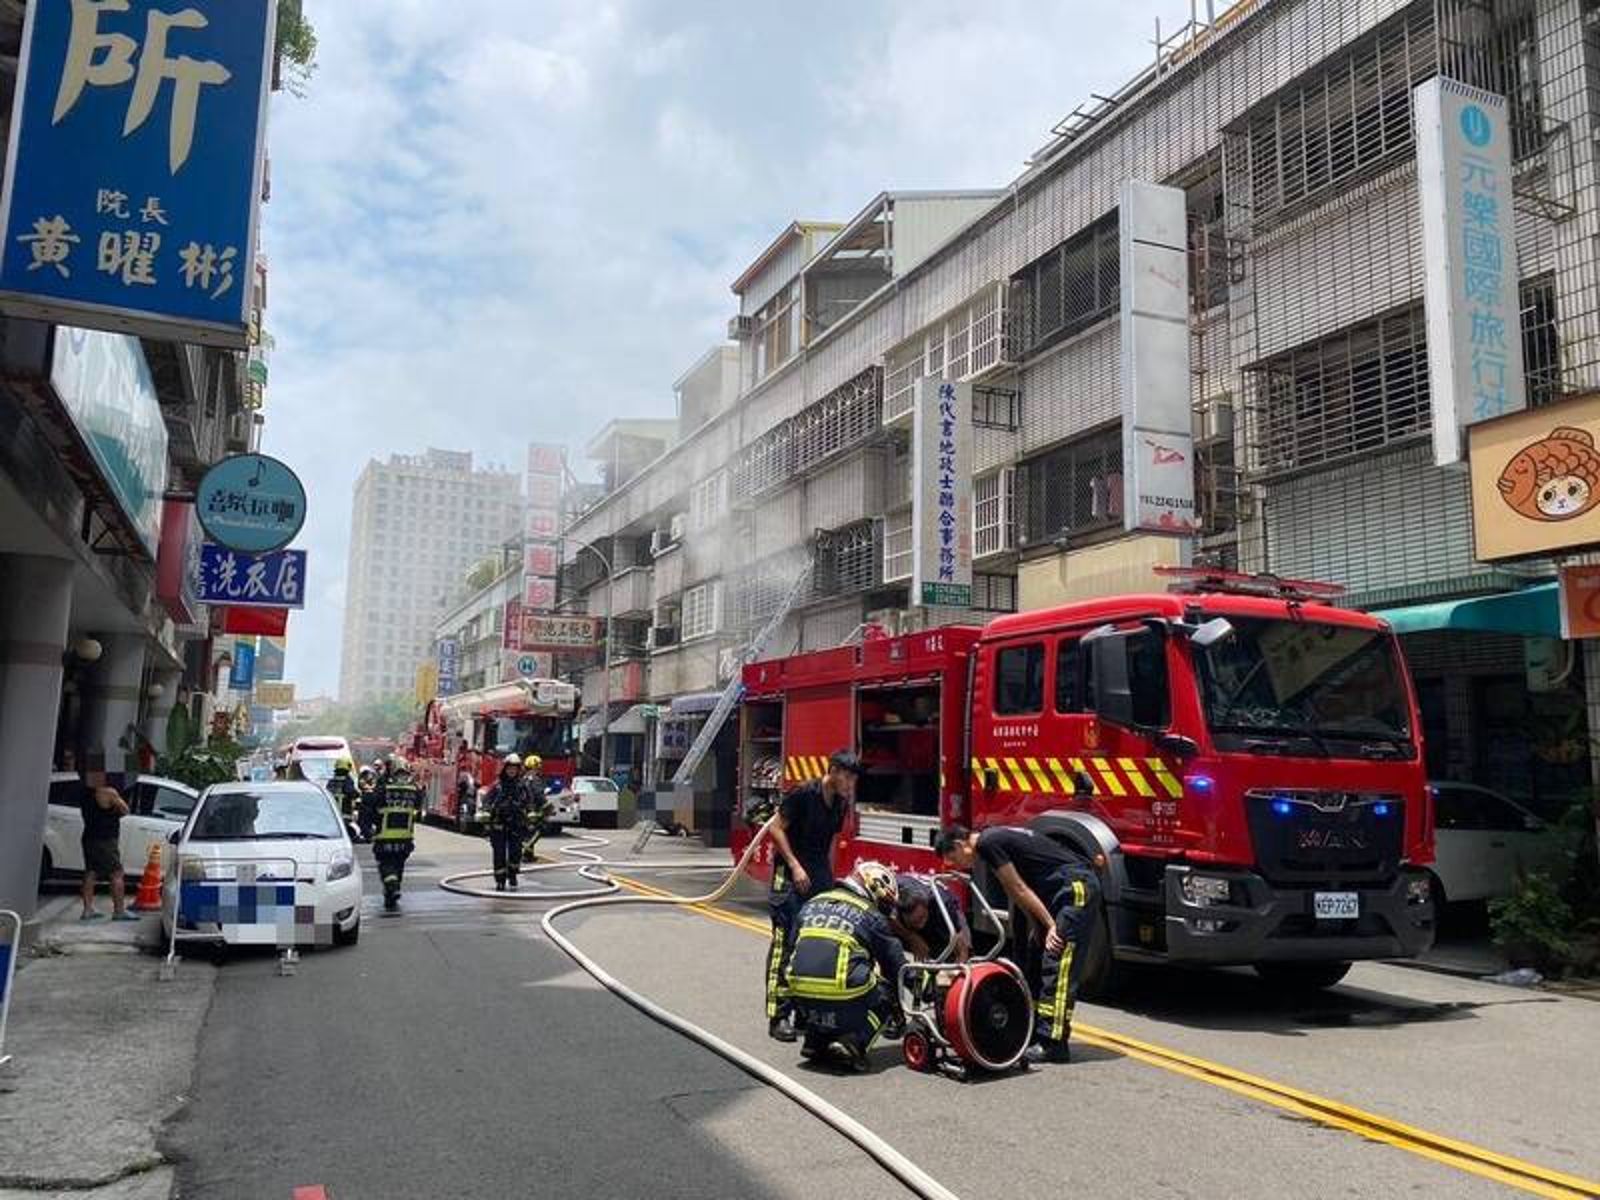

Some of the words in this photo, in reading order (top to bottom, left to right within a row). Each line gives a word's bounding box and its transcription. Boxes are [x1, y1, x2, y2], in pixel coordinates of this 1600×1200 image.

[52, 0, 232, 176] 所
[97, 188, 169, 225] 院長
[16, 215, 238, 300] 黃曜彬
